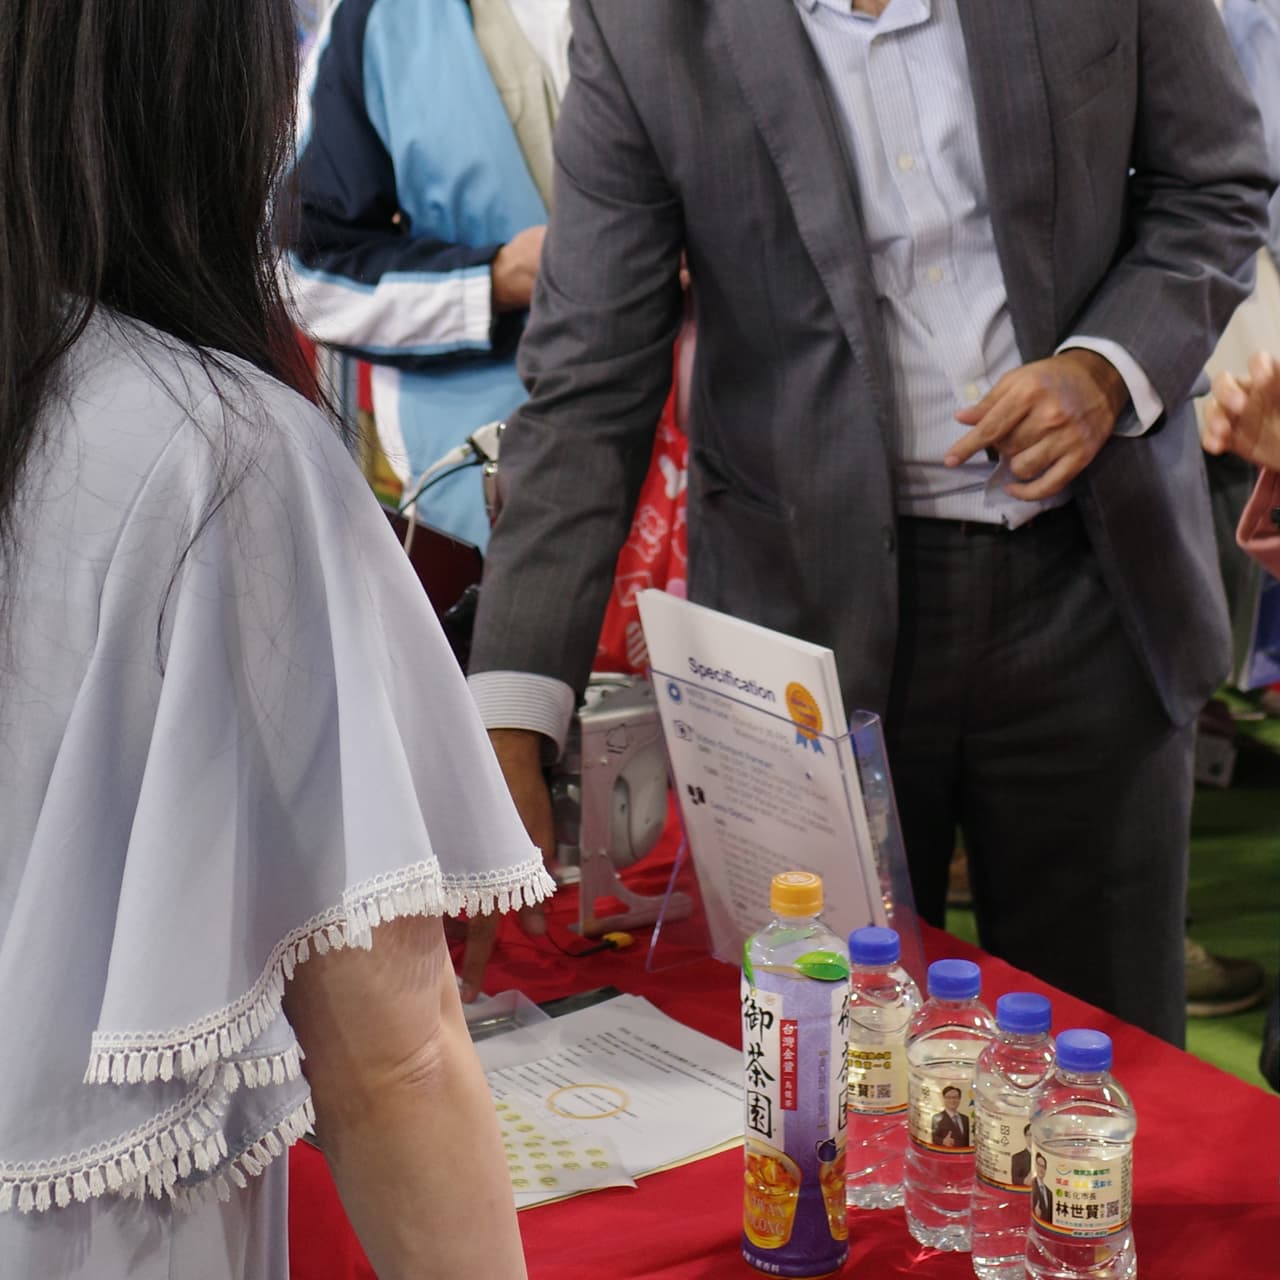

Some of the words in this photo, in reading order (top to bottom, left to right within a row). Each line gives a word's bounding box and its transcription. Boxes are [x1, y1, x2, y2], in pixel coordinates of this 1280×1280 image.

[687, 656, 776, 703] Specification
[744, 994, 775, 1139] 御茶園
[1055, 1200, 1099, 1220] 林世賢
